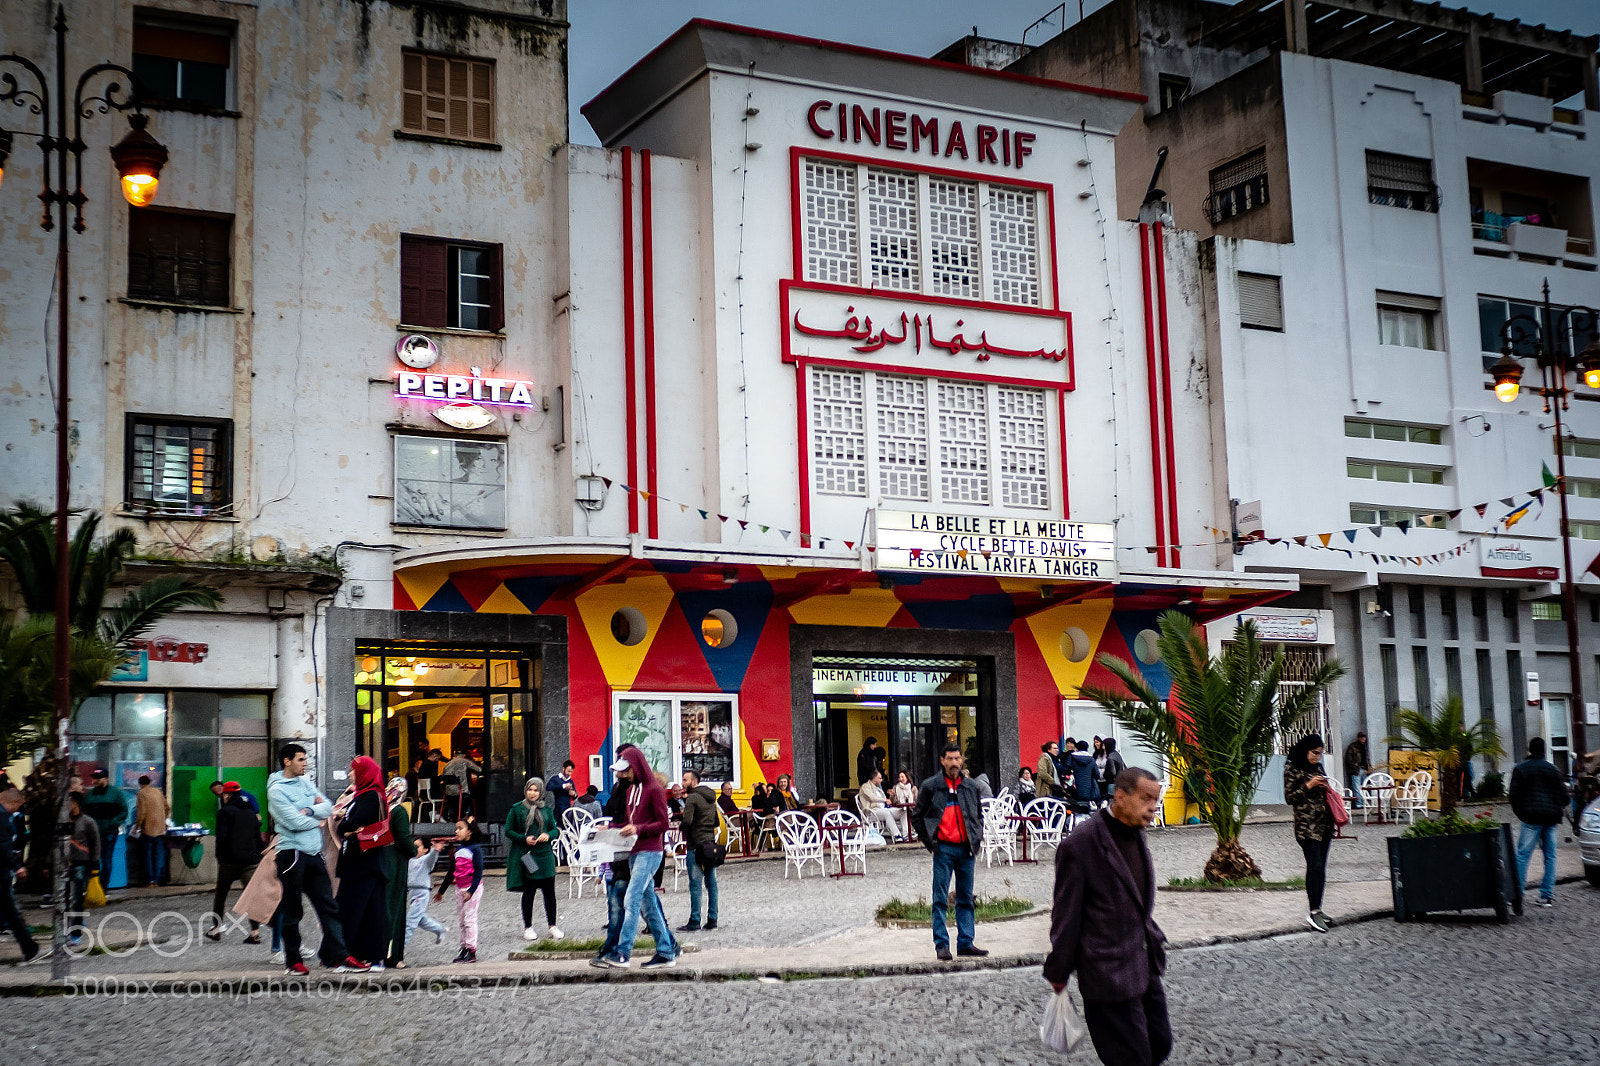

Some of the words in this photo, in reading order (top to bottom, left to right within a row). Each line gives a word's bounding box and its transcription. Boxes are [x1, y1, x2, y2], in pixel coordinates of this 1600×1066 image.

[793, 304, 923, 355] الريف
[926, 313, 1067, 362] سينما
[911, 513, 929, 530] LA
[936, 515, 981, 533] BELLE
[989, 518, 1006, 535] ET
[1014, 520, 1031, 536] LA
[1037, 522, 1085, 539] MEUTE
[940, 534, 986, 552] CYCLE
[1487, 549, 1533, 562] Amendis
[1044, 559, 1099, 577] TANGER
[904, 671, 917, 683] DE
[924, 672, 971, 684] TANGER
